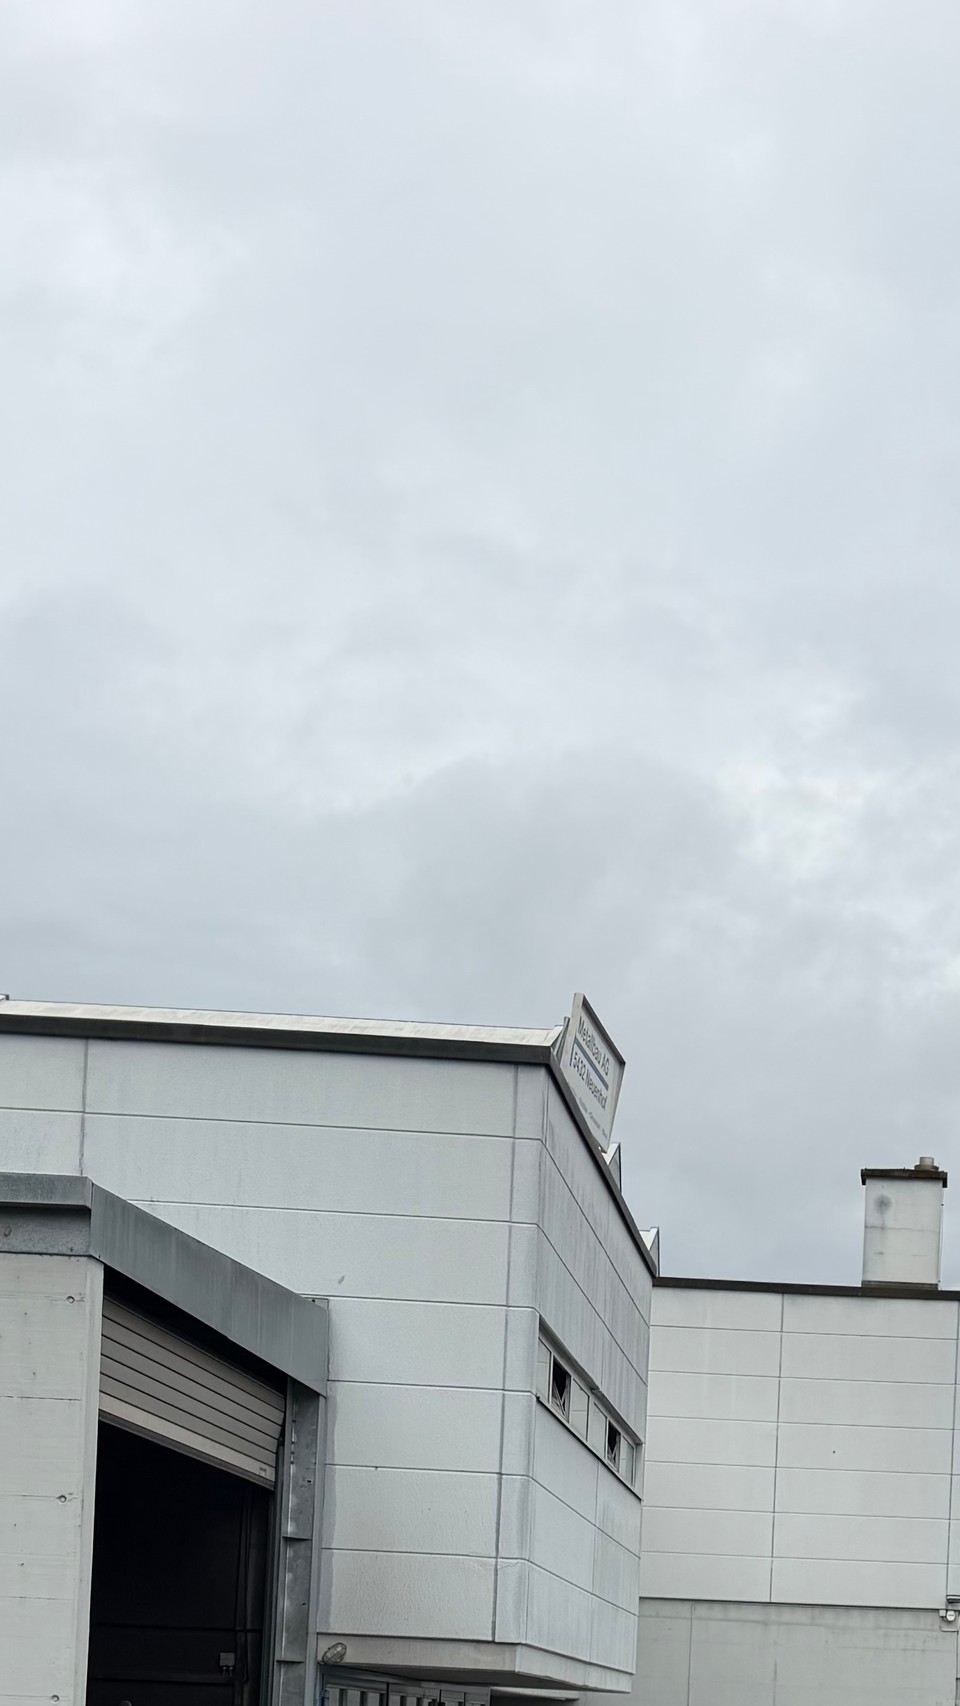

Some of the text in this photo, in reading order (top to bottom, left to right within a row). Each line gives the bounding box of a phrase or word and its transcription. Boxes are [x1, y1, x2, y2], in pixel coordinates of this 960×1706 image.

[578, 1015, 610, 1077] Metallbau AG
[572, 1051, 585, 1081] 5432
[584, 1069, 608, 1110] Neuenhof
